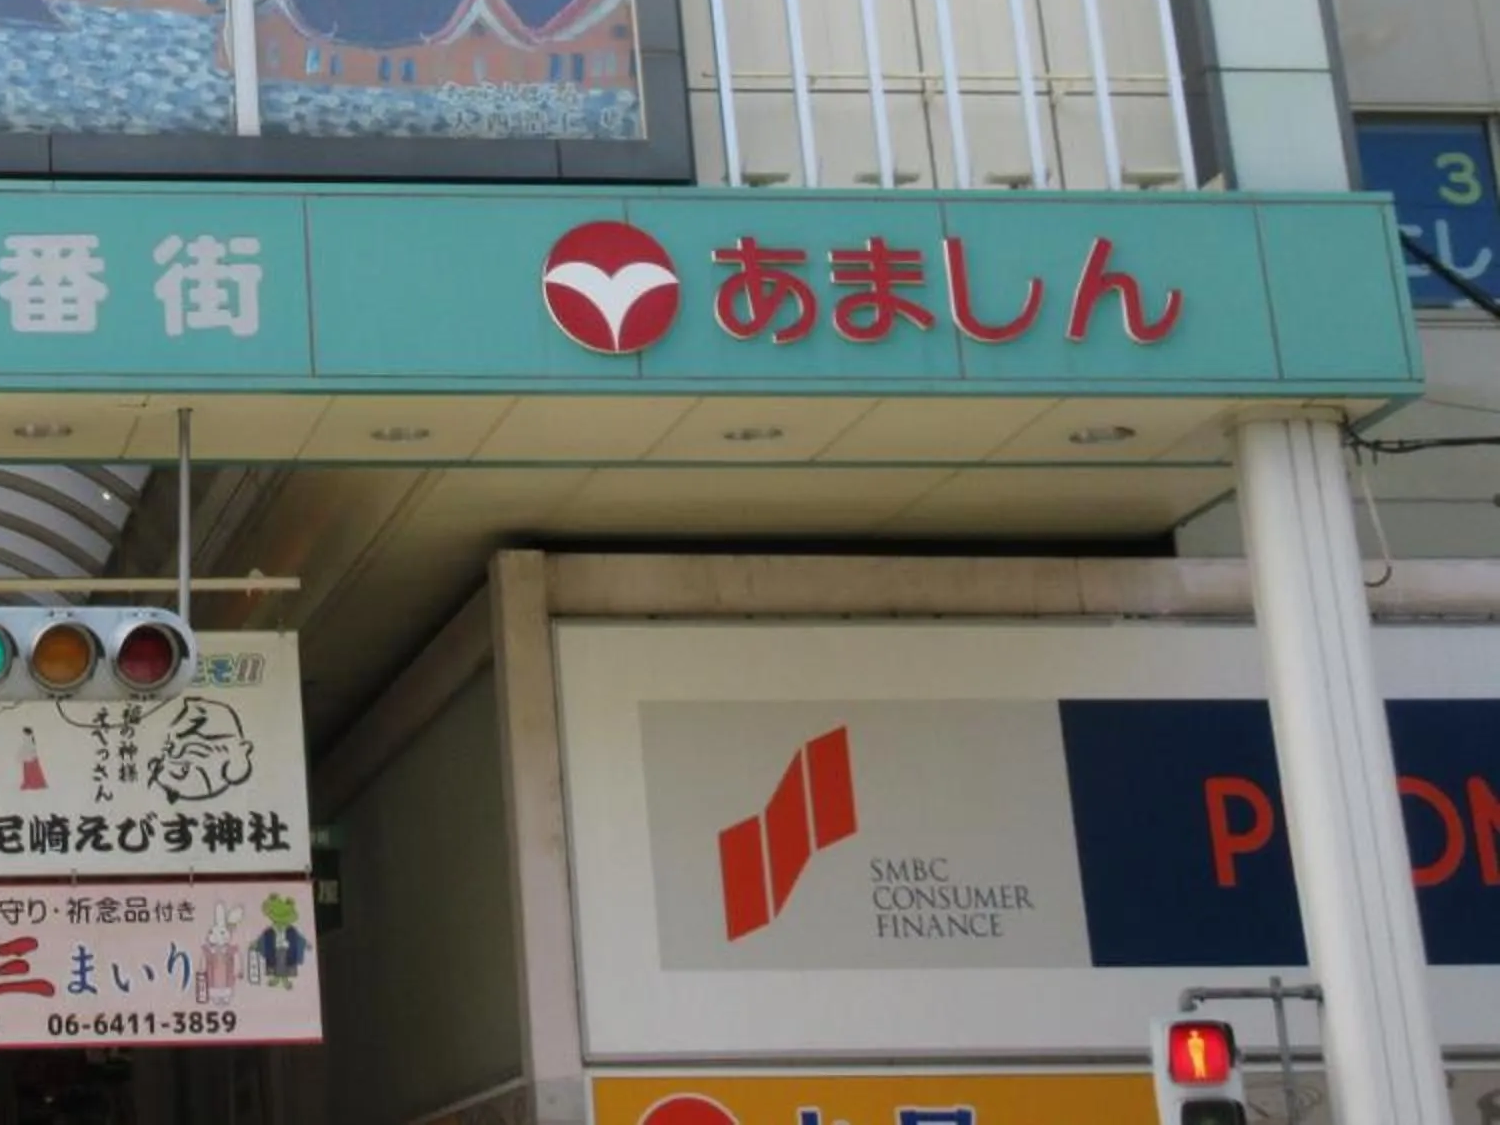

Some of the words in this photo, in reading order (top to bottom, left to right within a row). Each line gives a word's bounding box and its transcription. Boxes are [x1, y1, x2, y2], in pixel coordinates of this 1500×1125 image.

[710, 237, 1184, 345] あましん
[870, 857, 949, 883] SMBC
[873, 886, 1035, 911] CONSUMER
[876, 913, 1005, 939] FINANCE
[47, 1011, 237, 1036] 06-6411-3859
